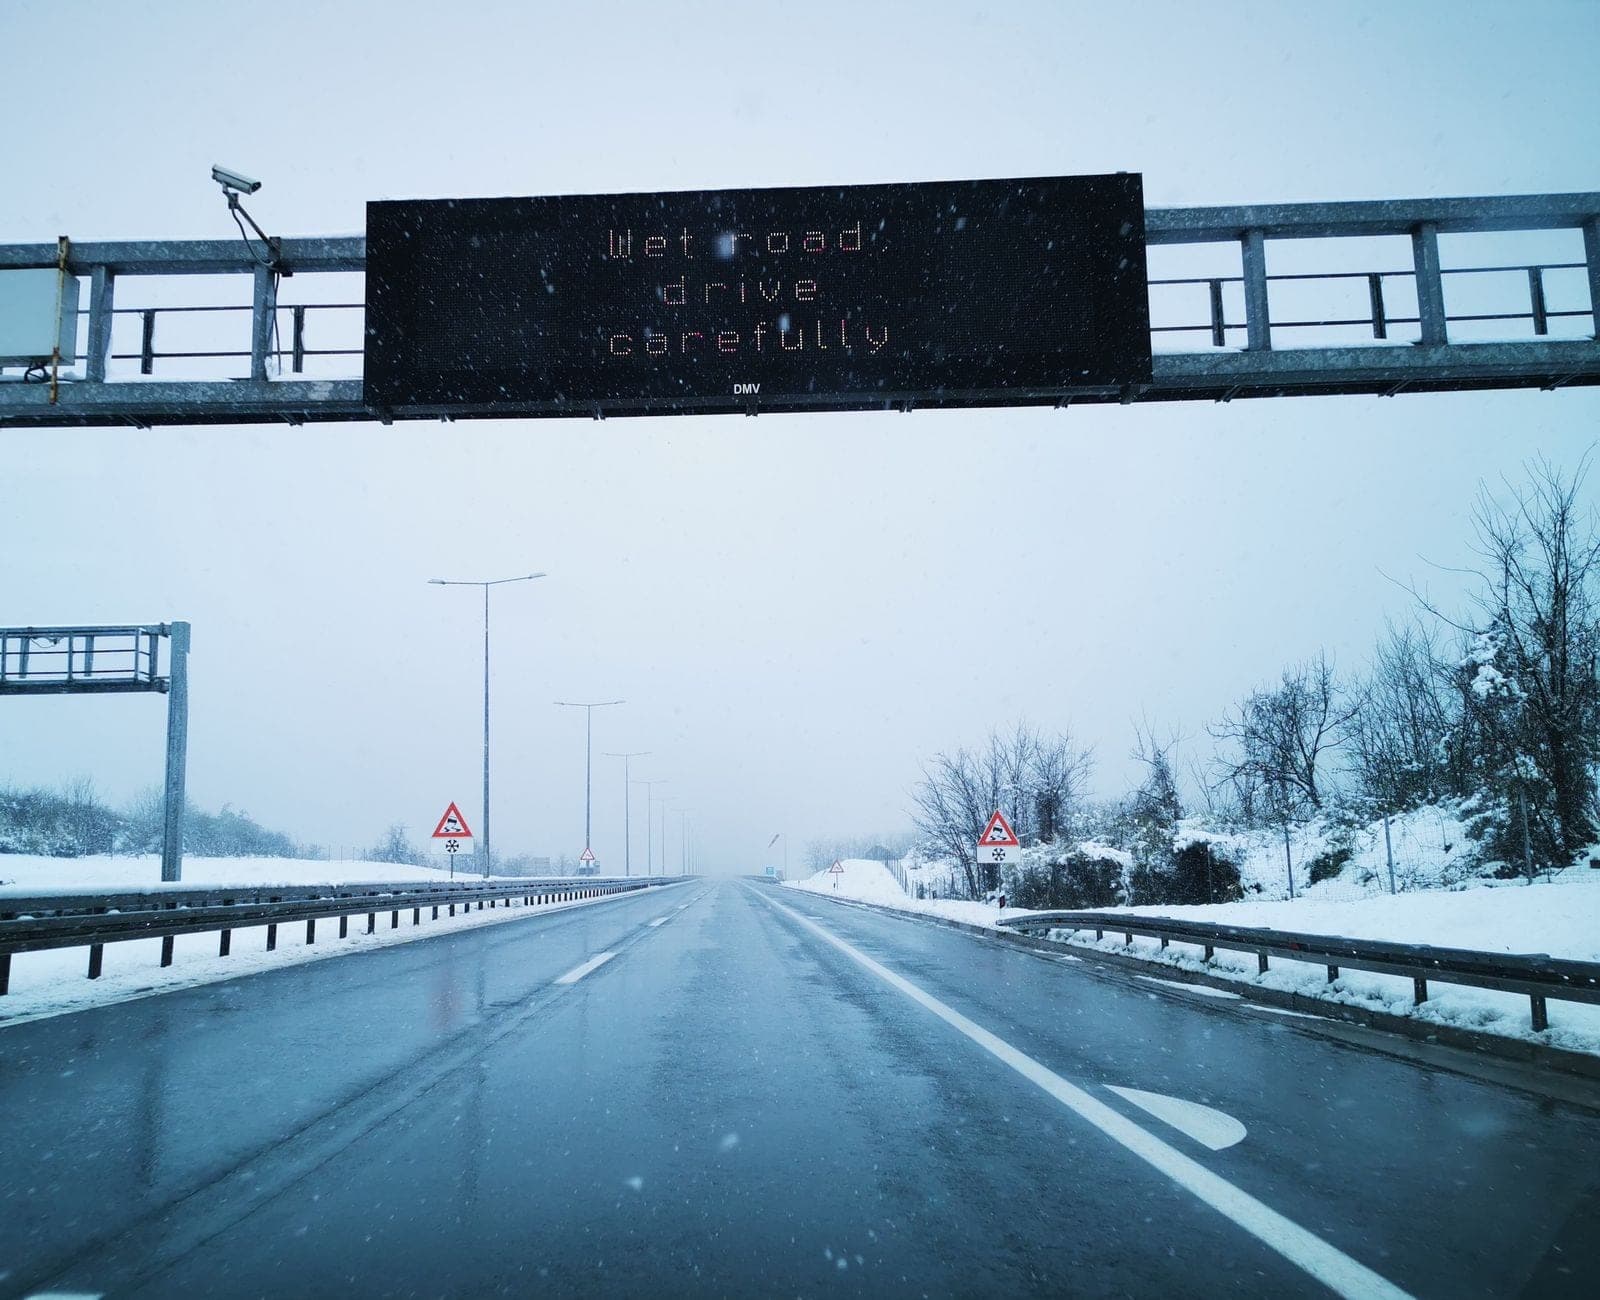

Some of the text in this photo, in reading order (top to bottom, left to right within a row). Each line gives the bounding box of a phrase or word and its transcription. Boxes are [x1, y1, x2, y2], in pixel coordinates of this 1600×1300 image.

[609, 227, 694, 259] Wet
[663, 274, 817, 305] drive
[609, 318, 889, 355] carefully
[733, 383, 761, 396] DMV
